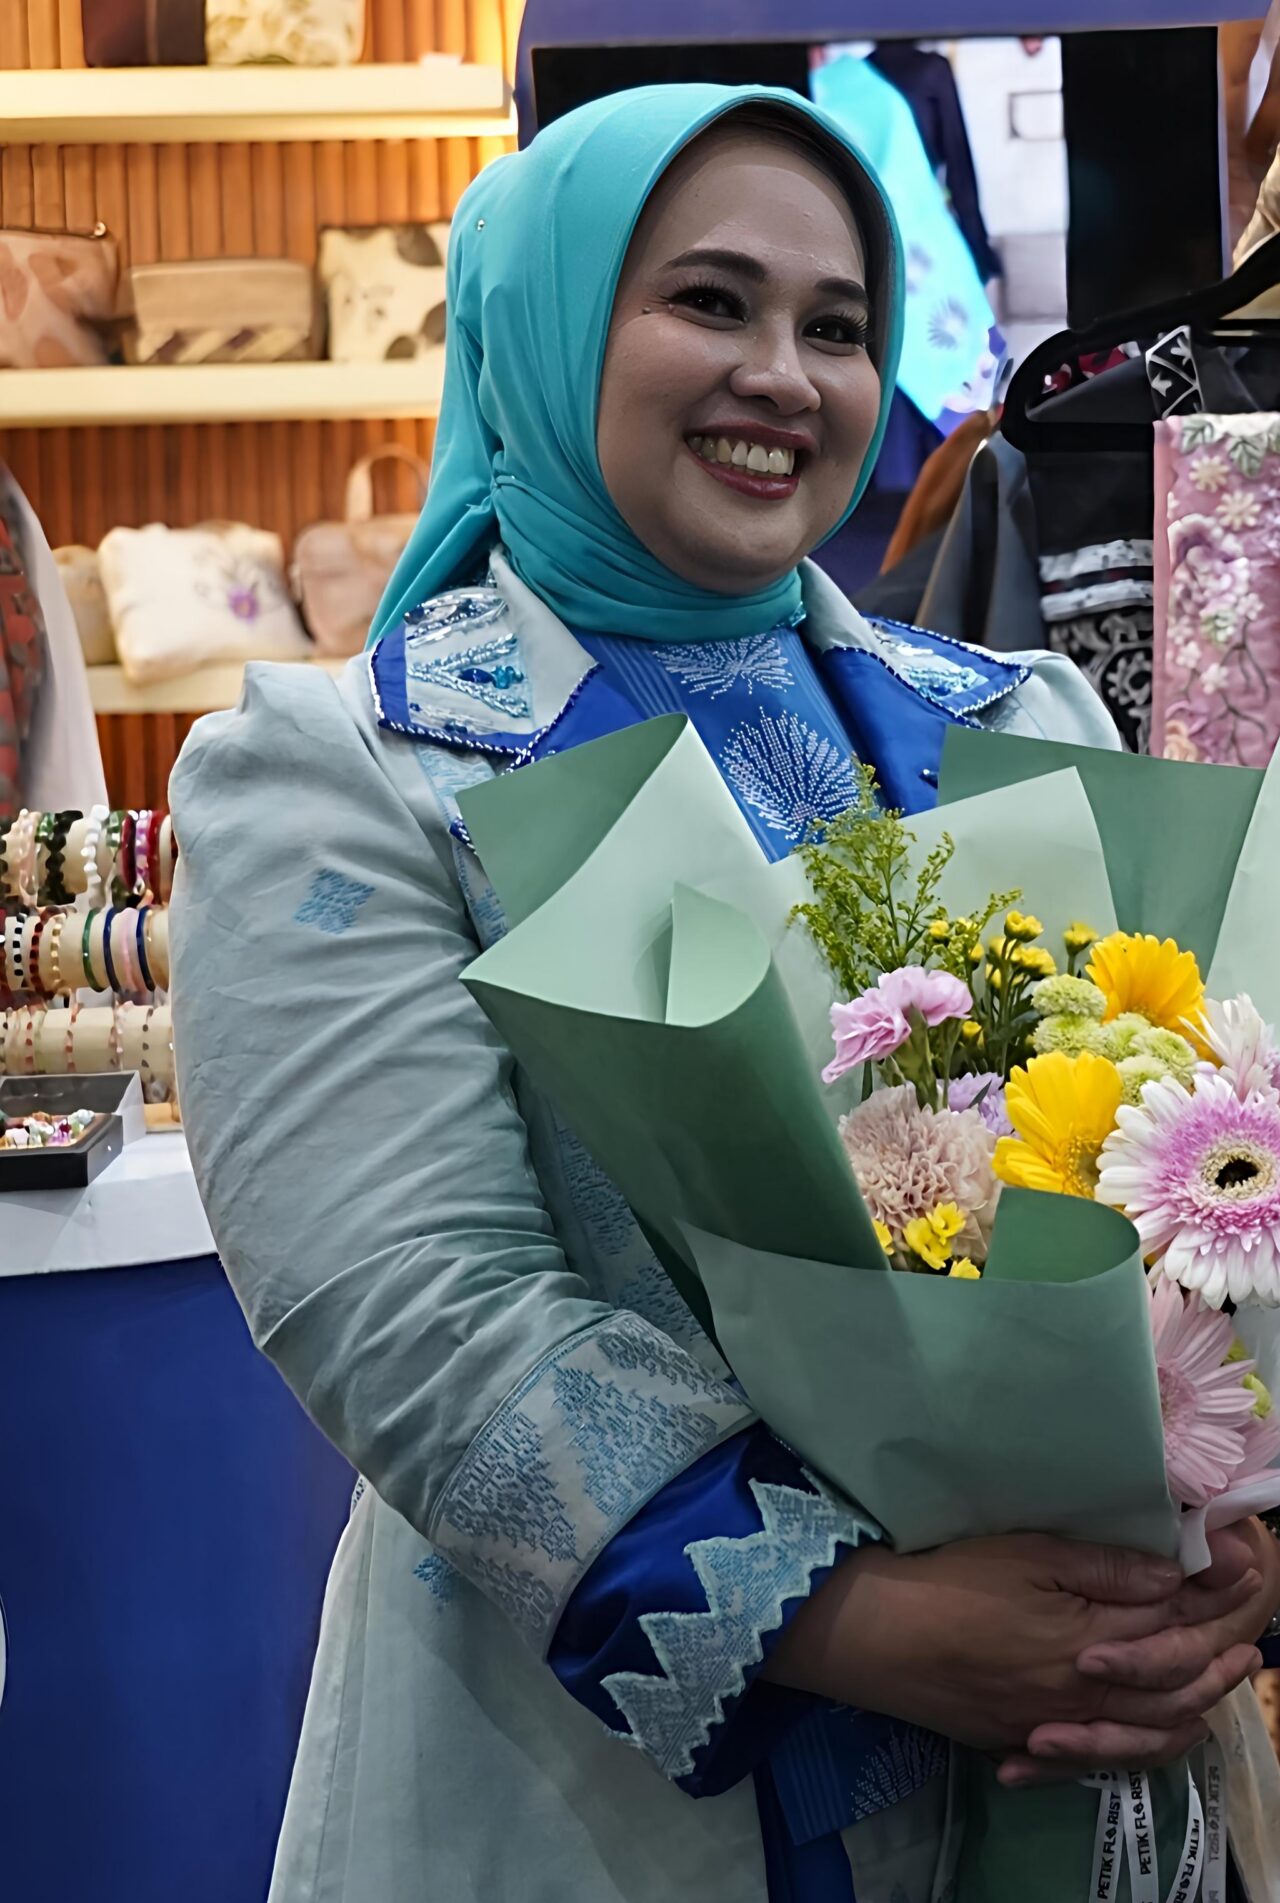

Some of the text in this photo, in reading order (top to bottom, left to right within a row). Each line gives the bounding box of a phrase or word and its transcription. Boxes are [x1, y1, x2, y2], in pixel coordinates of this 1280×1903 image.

[1136, 1833, 1151, 1876] PETIK
[1187, 1818, 1200, 1861] PETIK
[1097, 1858, 1114, 1900] PETIK
